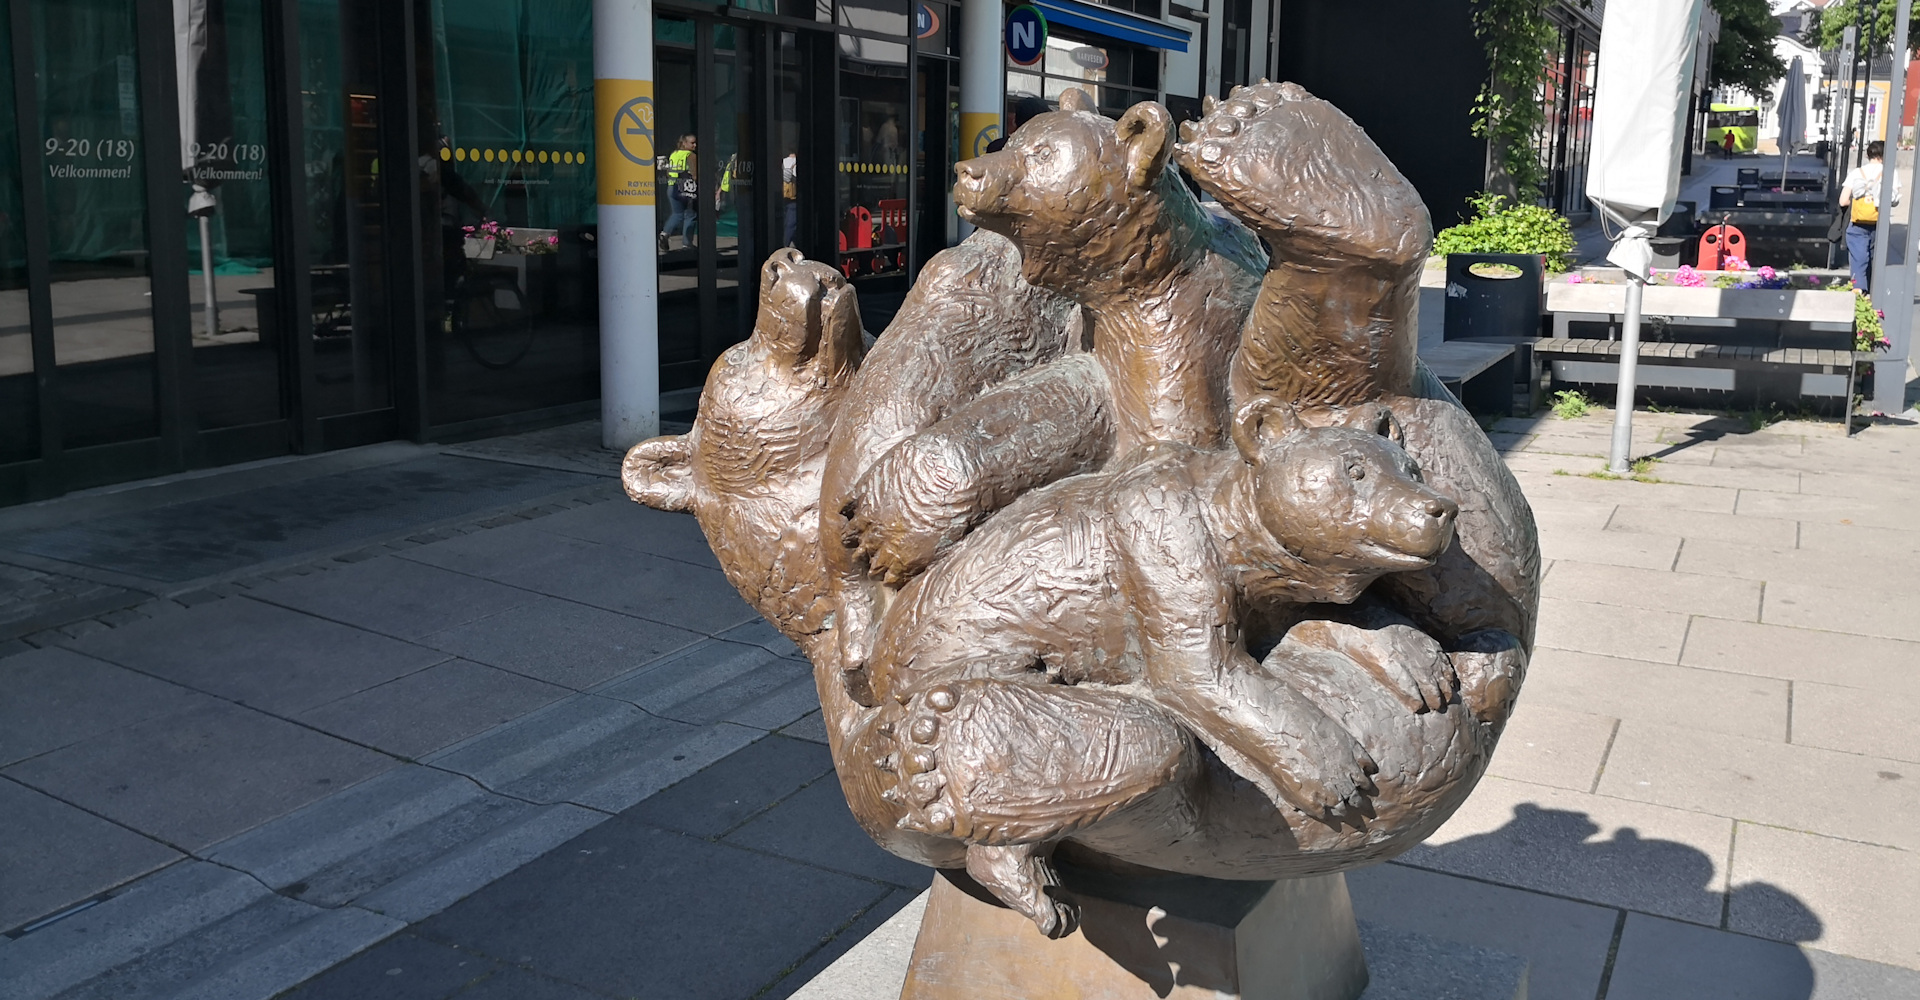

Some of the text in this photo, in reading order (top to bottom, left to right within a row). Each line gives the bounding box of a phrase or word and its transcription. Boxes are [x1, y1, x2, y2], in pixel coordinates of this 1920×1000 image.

[1012, 21, 1035, 49] N
[1076, 50, 1104, 65] NARVESEN
[45, 138, 135, 161] 9-20 (18)
[188, 142, 266, 164] 9-20 (18)
[50, 165, 131, 178] Velkommen!
[193, 167, 262, 180] Velkommen!
